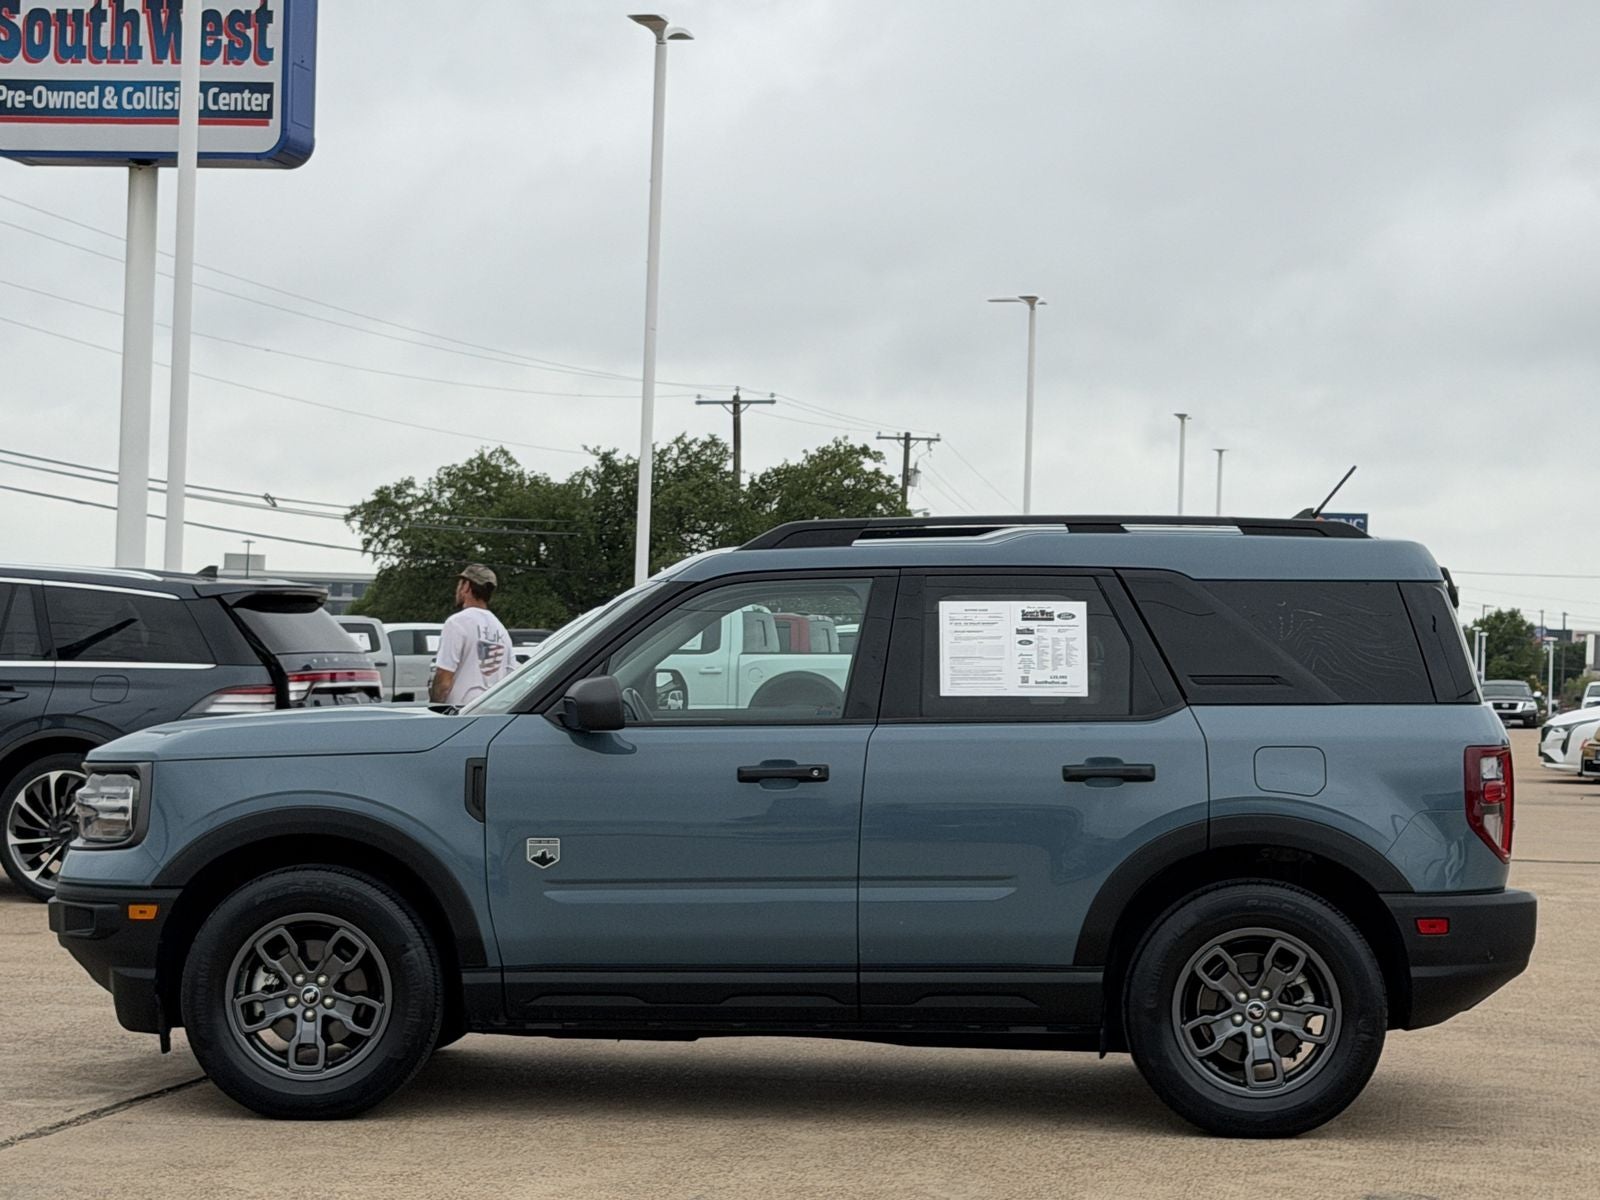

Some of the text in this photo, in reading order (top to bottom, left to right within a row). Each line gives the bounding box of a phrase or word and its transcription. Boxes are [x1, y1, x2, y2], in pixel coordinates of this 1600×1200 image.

[0, 85, 271, 112] Pre-Owned & Collisi Center
